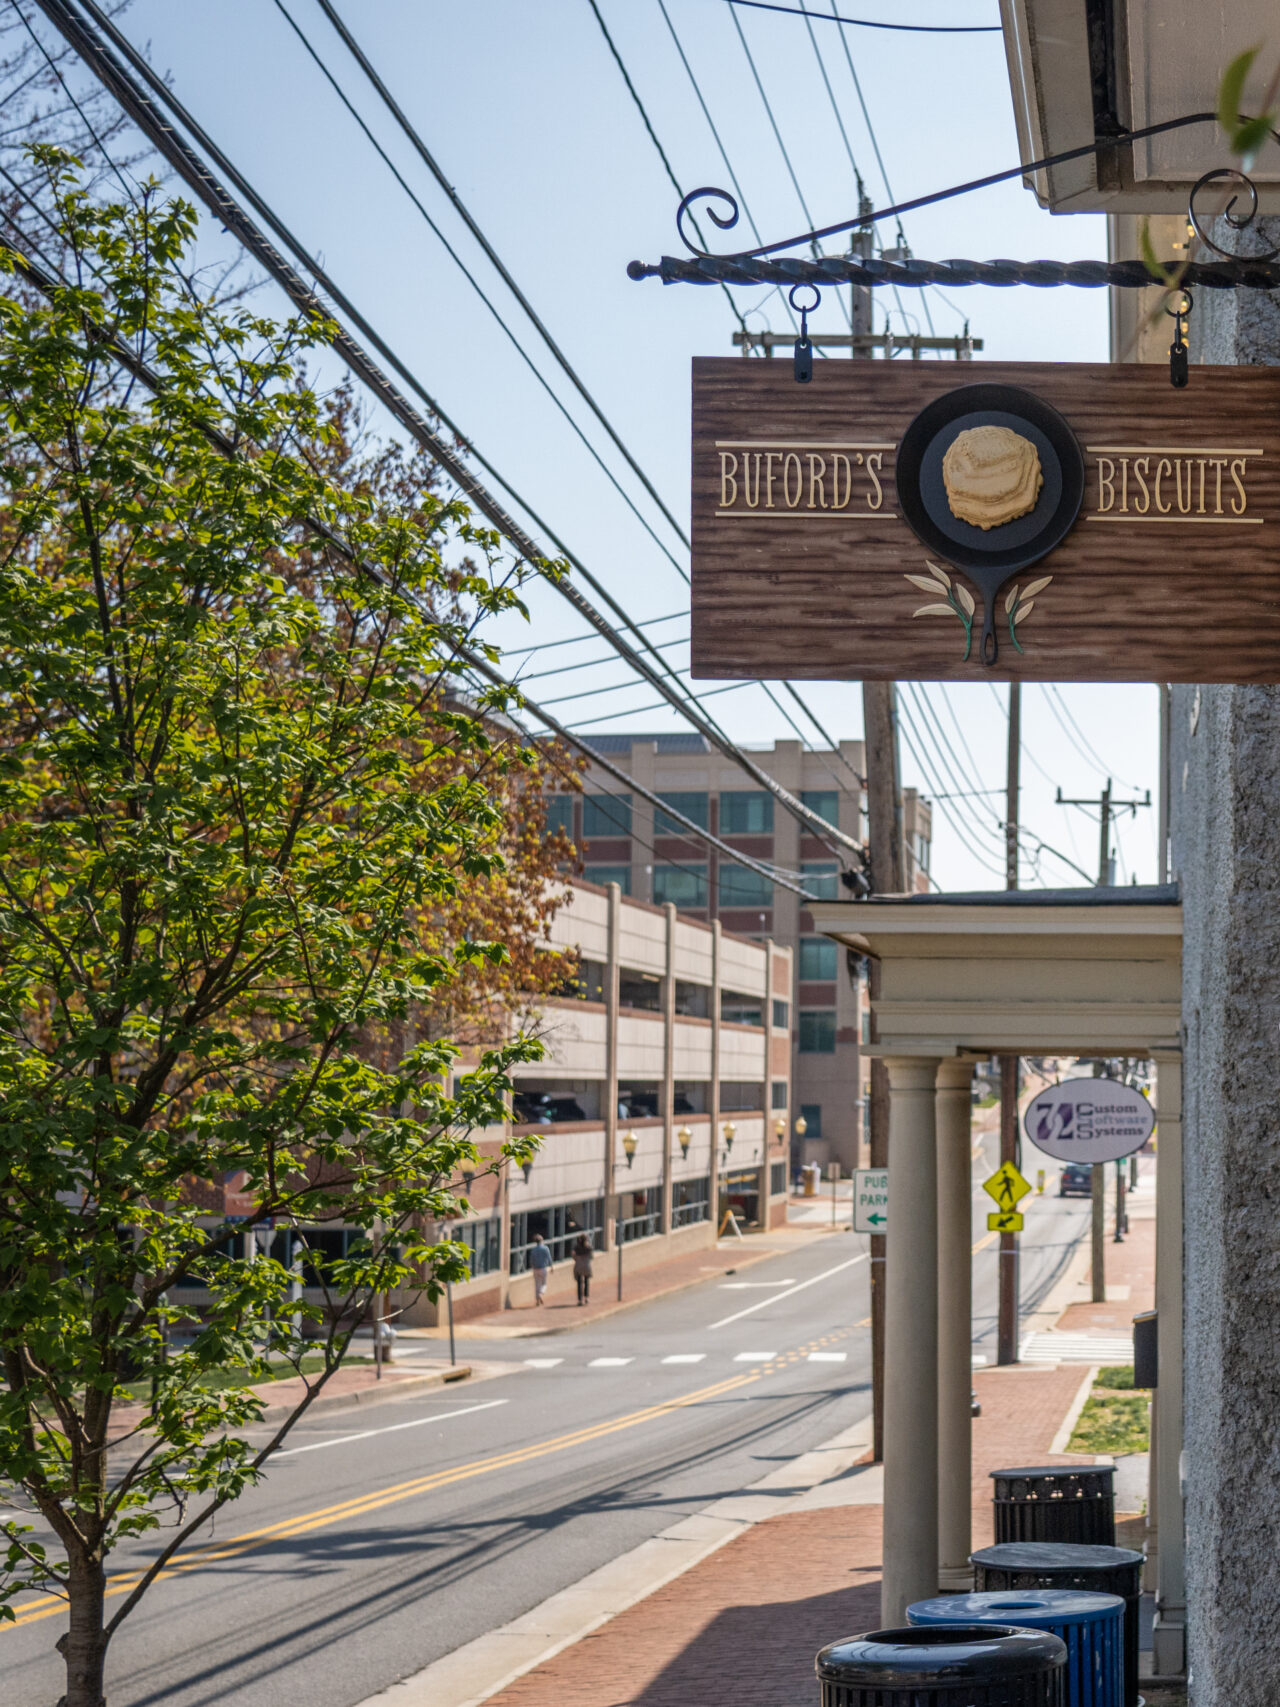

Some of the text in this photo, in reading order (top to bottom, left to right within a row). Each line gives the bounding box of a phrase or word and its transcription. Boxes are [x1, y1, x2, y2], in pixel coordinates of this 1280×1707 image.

[718, 452, 1247, 514] BUFORD'S BISCUITS
[1076, 1103, 1138, 1116] Custom
[1077, 1114, 1148, 1128] Software
[1076, 1123, 1144, 1139] Systems
